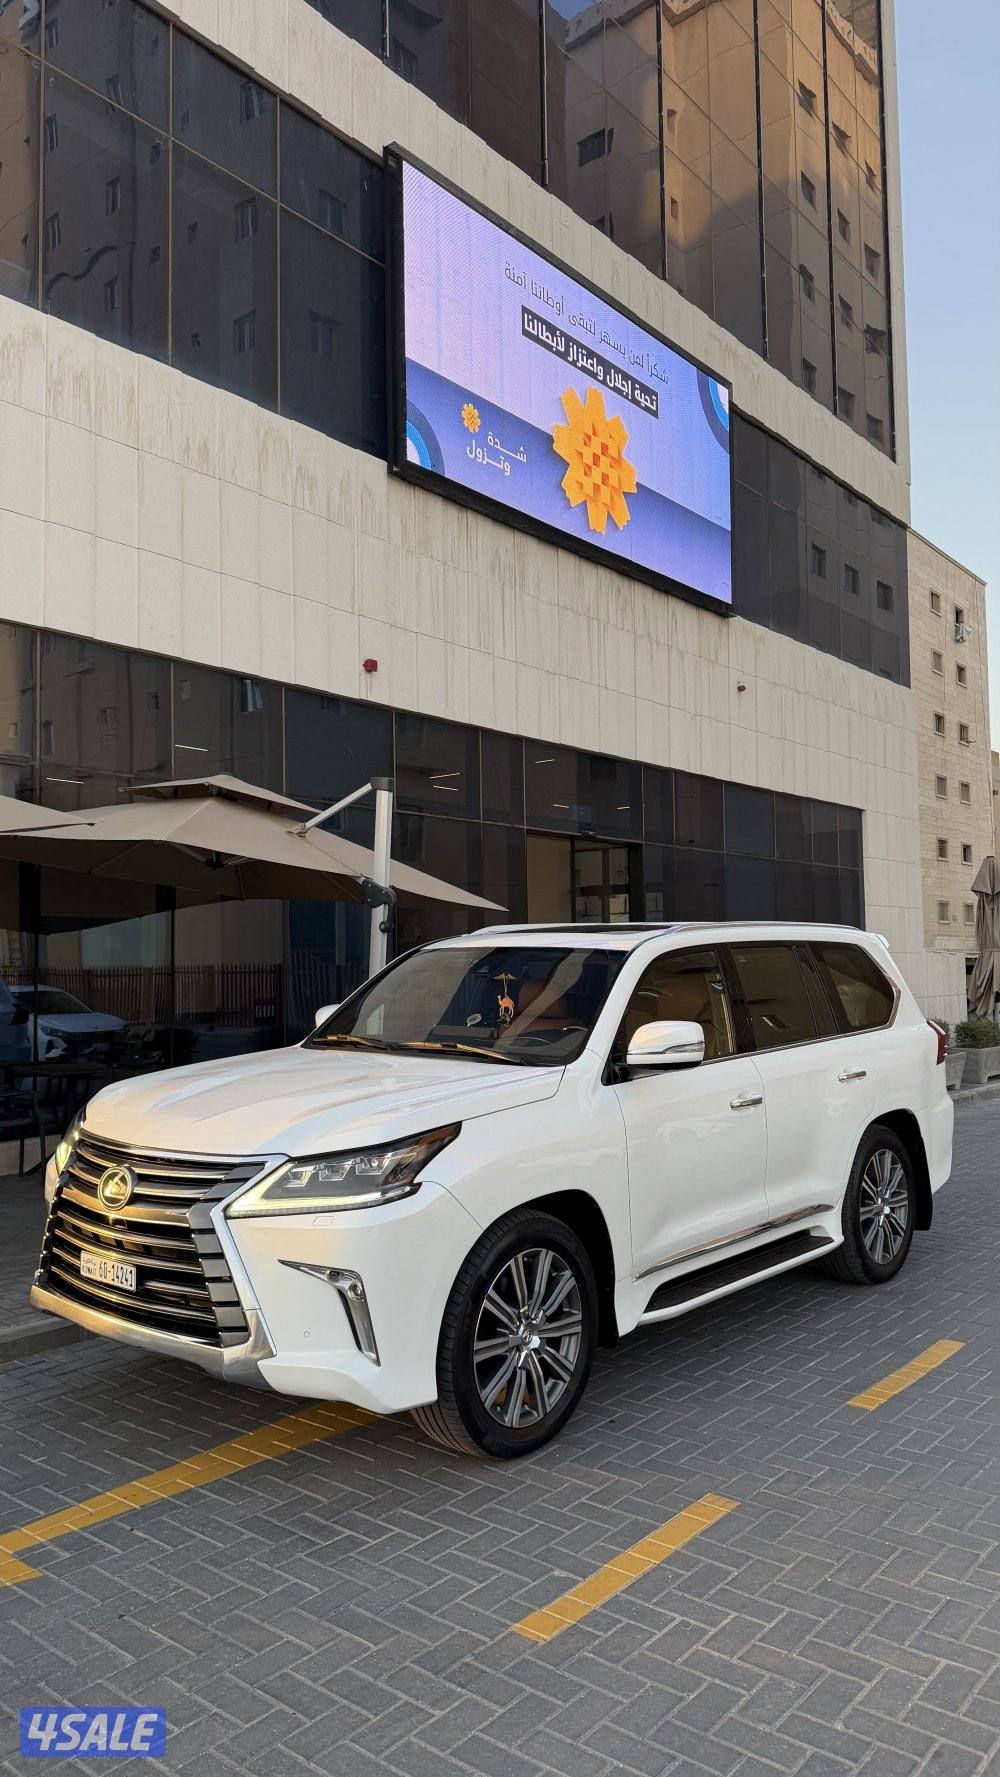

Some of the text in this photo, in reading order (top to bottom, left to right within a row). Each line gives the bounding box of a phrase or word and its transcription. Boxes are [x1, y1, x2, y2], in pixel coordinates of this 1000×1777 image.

[504, 261, 669, 384] شكراً لمن يسهر لتبقى أوطاننا آمنة
[524, 313, 657, 411] تحية إجلال واعتزاز لأبطالنا
